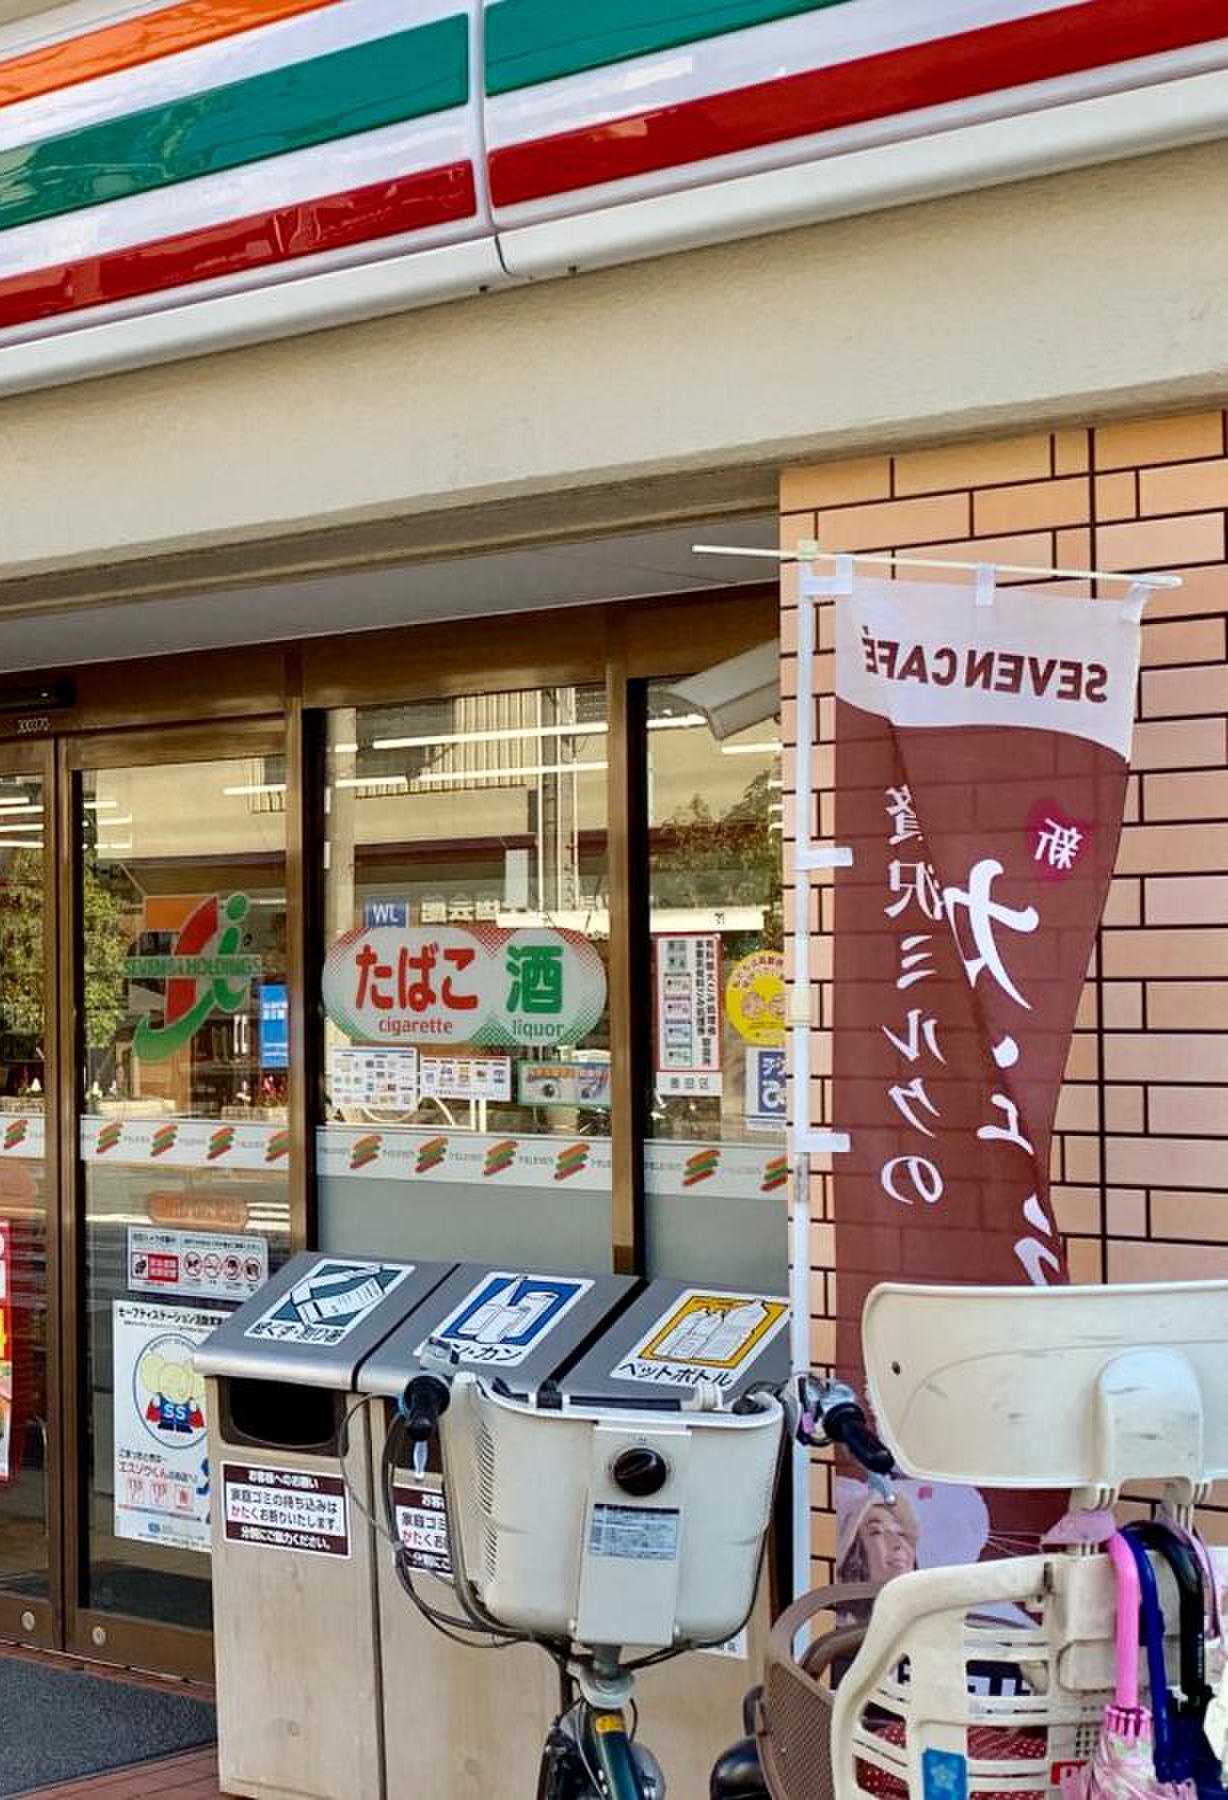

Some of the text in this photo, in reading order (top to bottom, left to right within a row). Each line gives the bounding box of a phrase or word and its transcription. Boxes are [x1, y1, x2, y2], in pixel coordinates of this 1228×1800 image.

[356, 944, 564, 1014] たばこ 酒
[379, 1016, 565, 1038] cigarette liquor
[618, 1362, 733, 1388] ペットボトル
[230, 1487, 338, 1516] 家庭ゴミの持ち込みは
